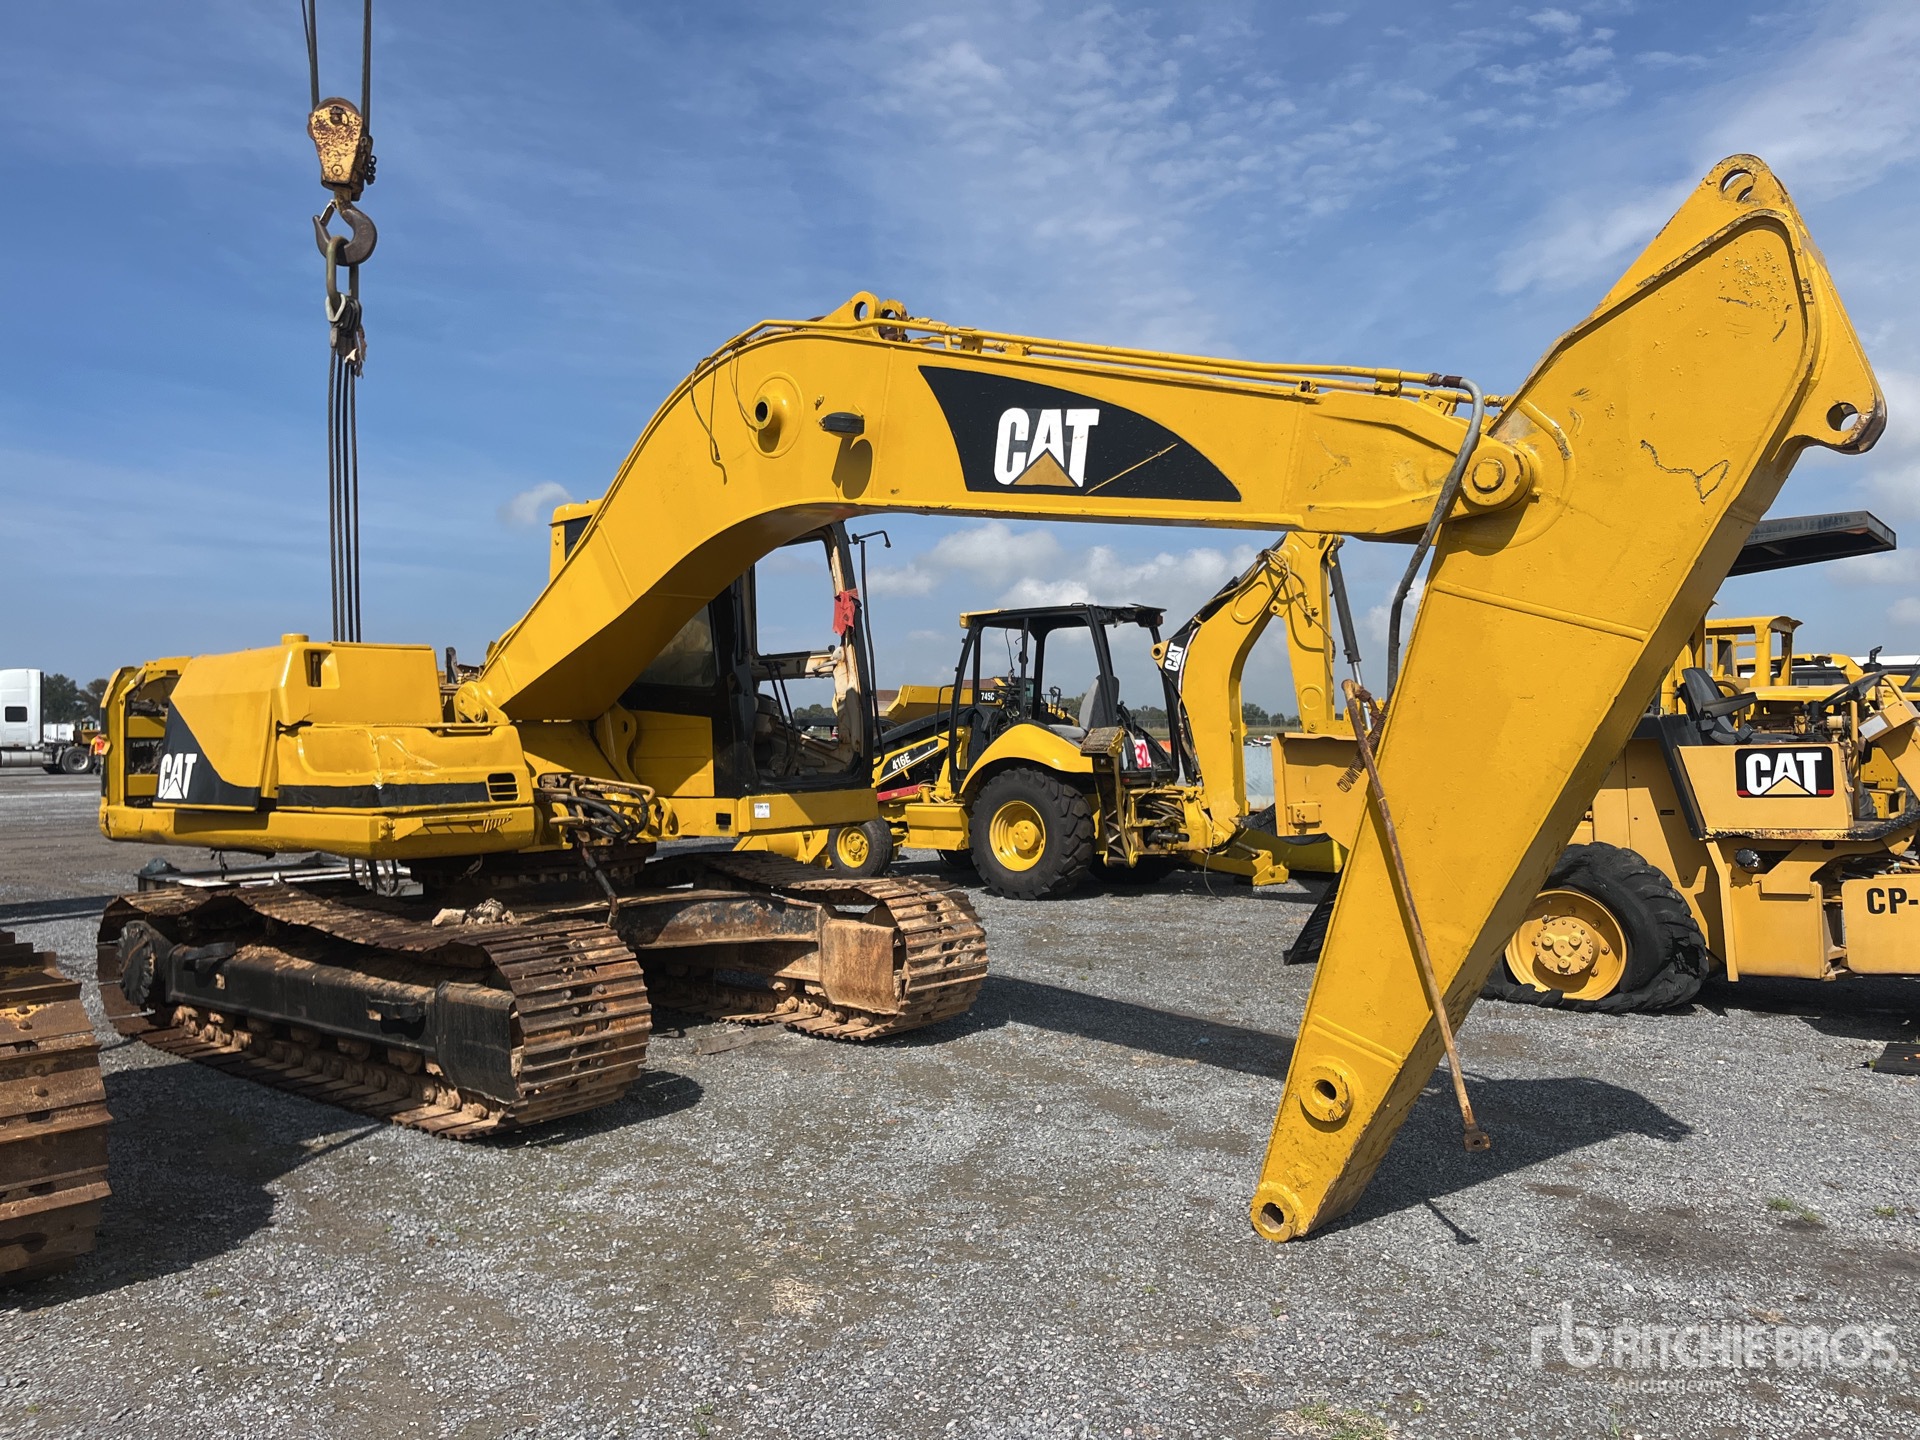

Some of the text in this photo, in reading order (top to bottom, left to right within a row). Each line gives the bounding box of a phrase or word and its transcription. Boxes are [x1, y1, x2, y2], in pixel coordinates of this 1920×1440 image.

[993, 407, 1100, 488] CAT
[1164, 642, 1184, 672] CAT
[980, 692, 995, 701] 745C
[157, 752, 198, 800] CAT
[892, 752, 911, 770] 416E
[1745, 751, 1823, 796] CAT
[1866, 887, 1919, 915] CP-
